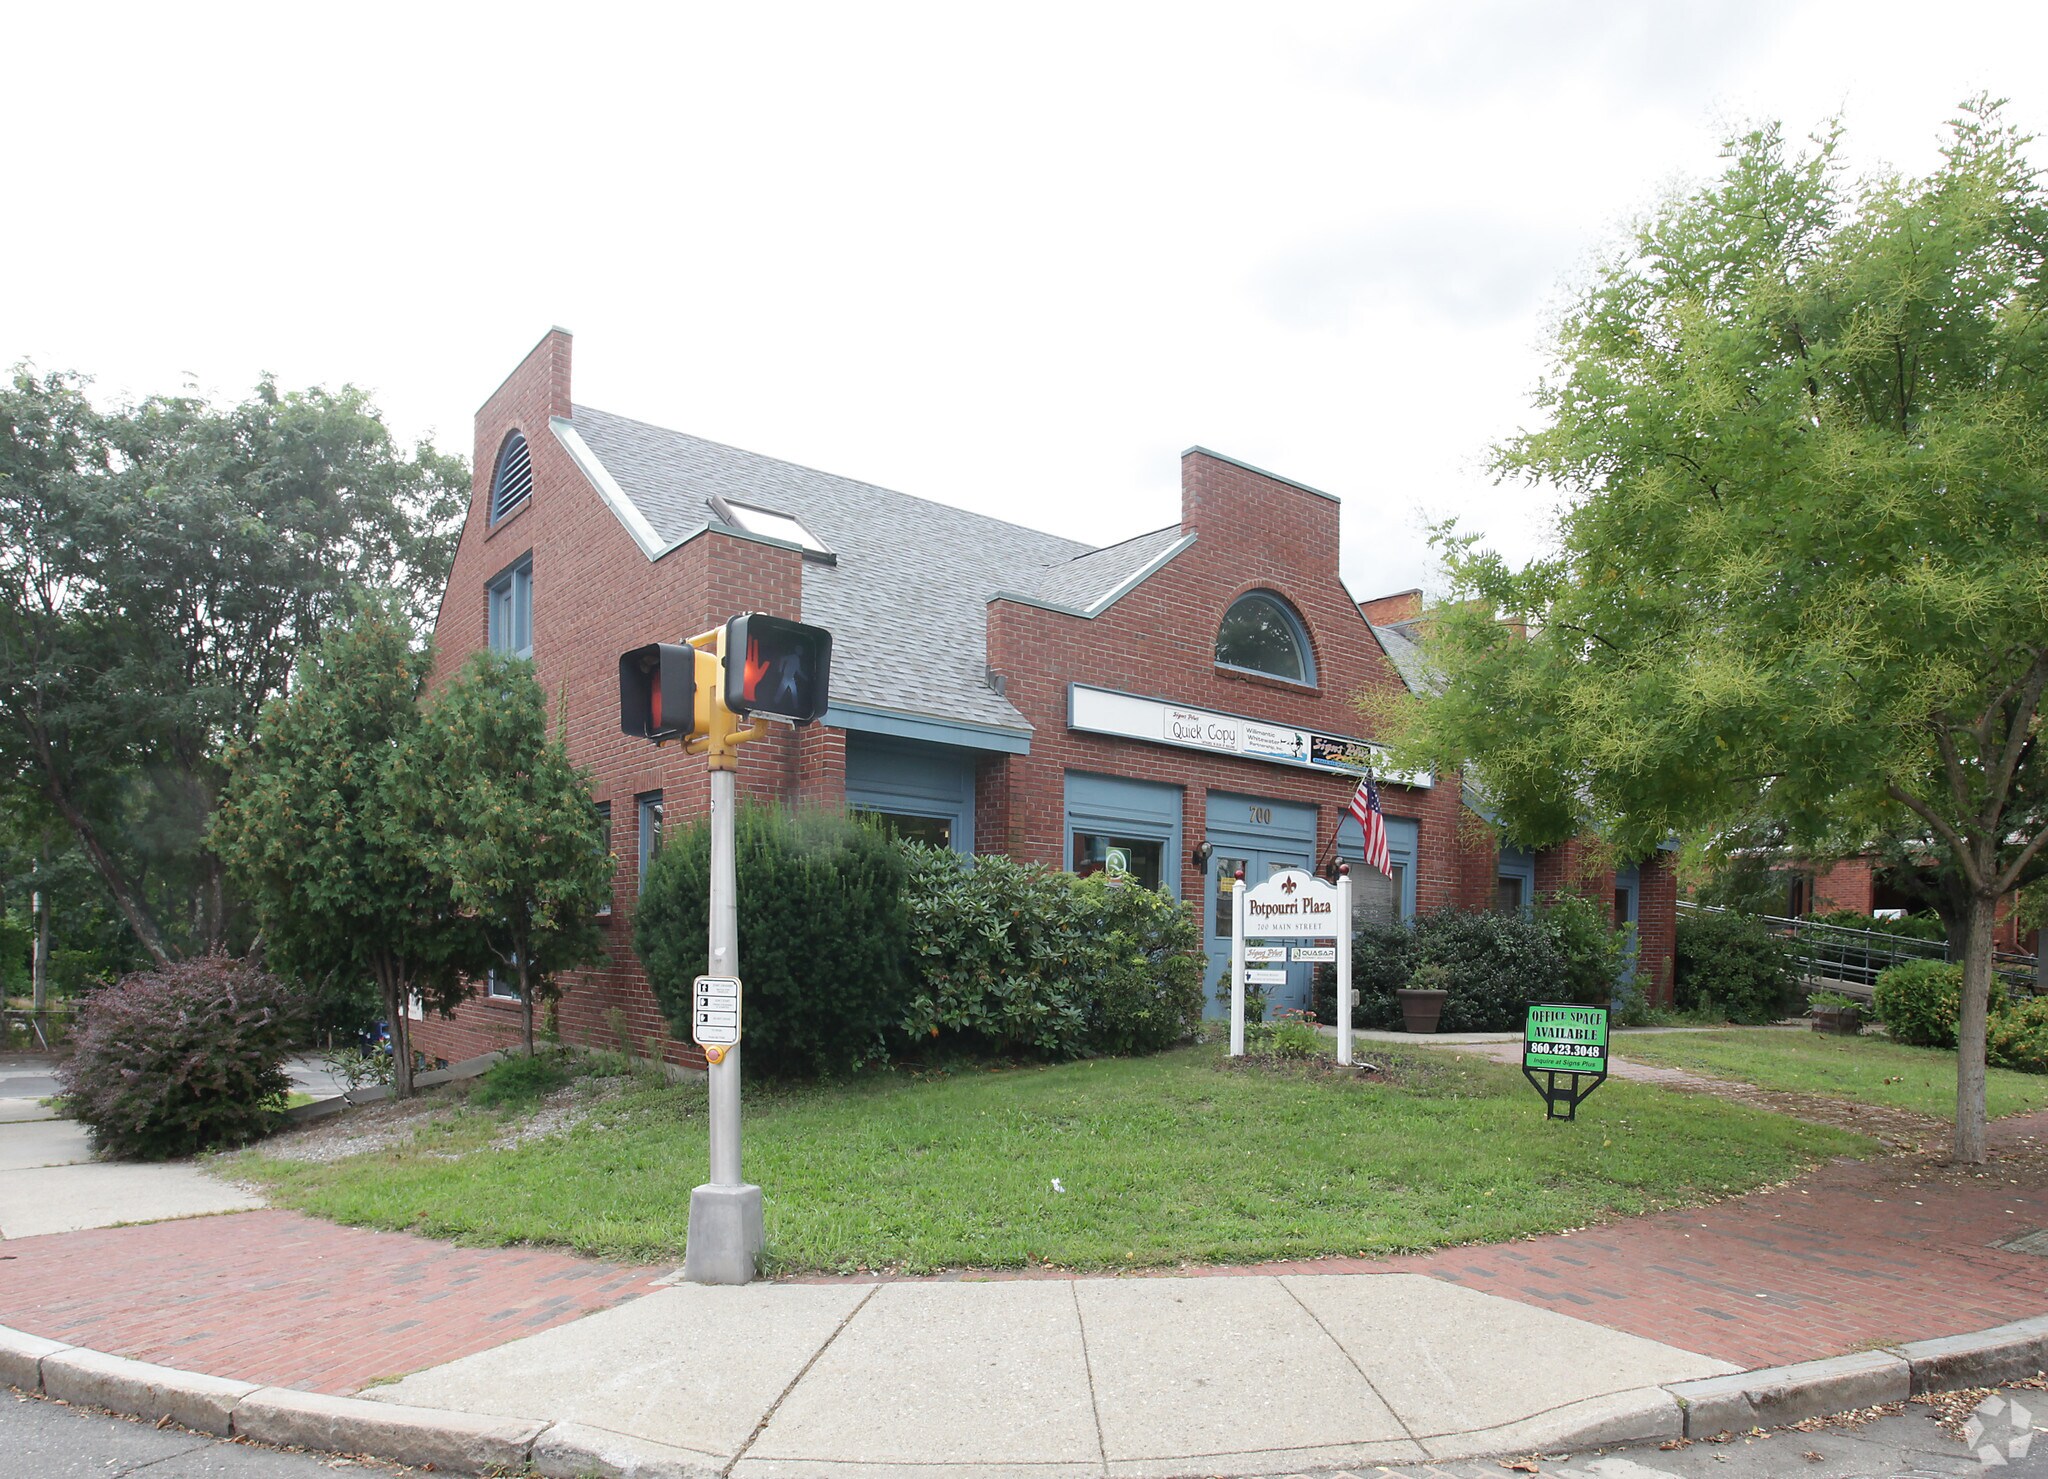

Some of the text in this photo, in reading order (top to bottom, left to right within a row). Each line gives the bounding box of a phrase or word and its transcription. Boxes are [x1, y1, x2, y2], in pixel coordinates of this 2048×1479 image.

[1172, 721, 1236, 744] Quick Copy
[1246, 727, 1276, 738] Willimantic
[1247, 734, 1280, 745] Whitewater
[1249, 805, 1271, 824] 700
[1250, 897, 1331, 918] Potpourri Plaza
[1532, 1009, 1567, 1023] OFFICE
[1570, 1011, 1602, 1026] SPACE
[1534, 1026, 1598, 1041] AVAILABLE
[1531, 1042, 1600, 1057] 860.423.3048
[1533, 1057, 1555, 1065] Inquire
[1562, 1059, 1580, 1067] Signs
[1581, 1060, 1596, 1068] Plus
